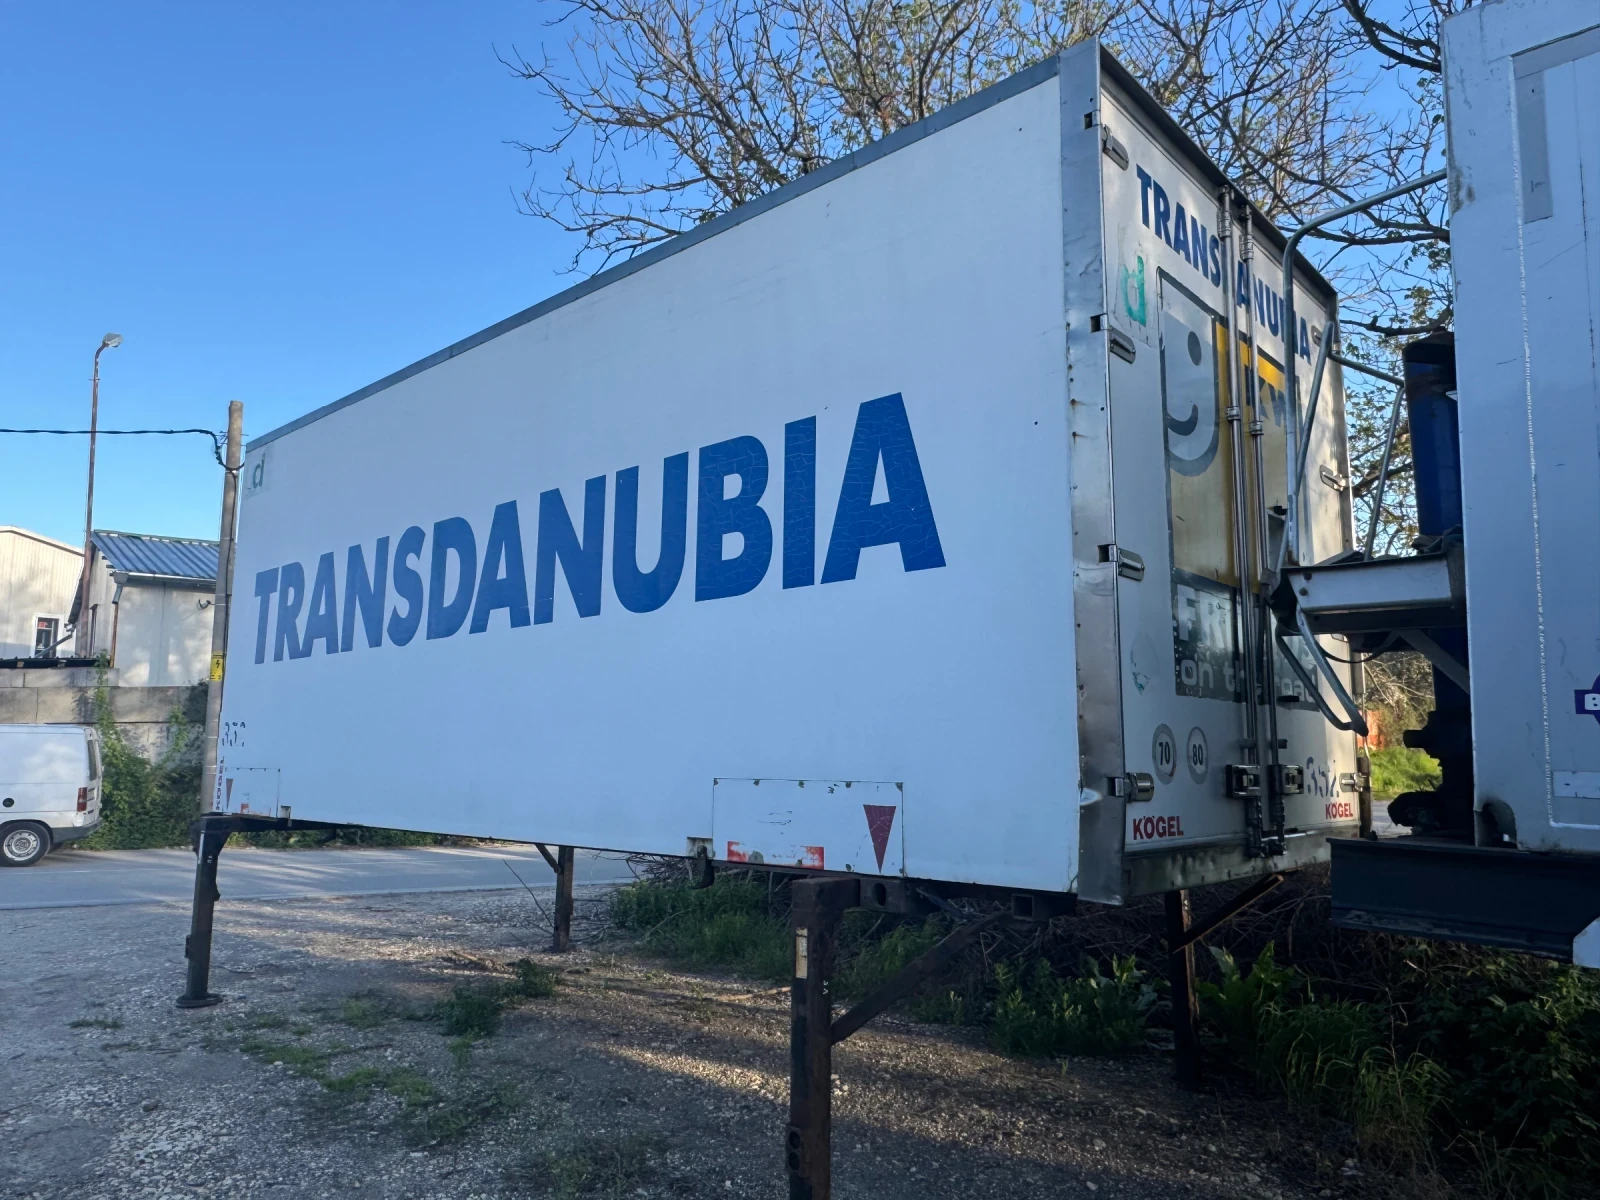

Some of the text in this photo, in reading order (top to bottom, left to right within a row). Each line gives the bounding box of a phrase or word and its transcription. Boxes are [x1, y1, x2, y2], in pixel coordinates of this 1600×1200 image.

[253, 392, 947, 665] TRANSDANUBIA
[1158, 741, 1171, 766] 70
[1192, 743, 1204, 766] 80
[1325, 802, 1354, 820] KÖGEL
[1132, 815, 1184, 841] KÖGEL
